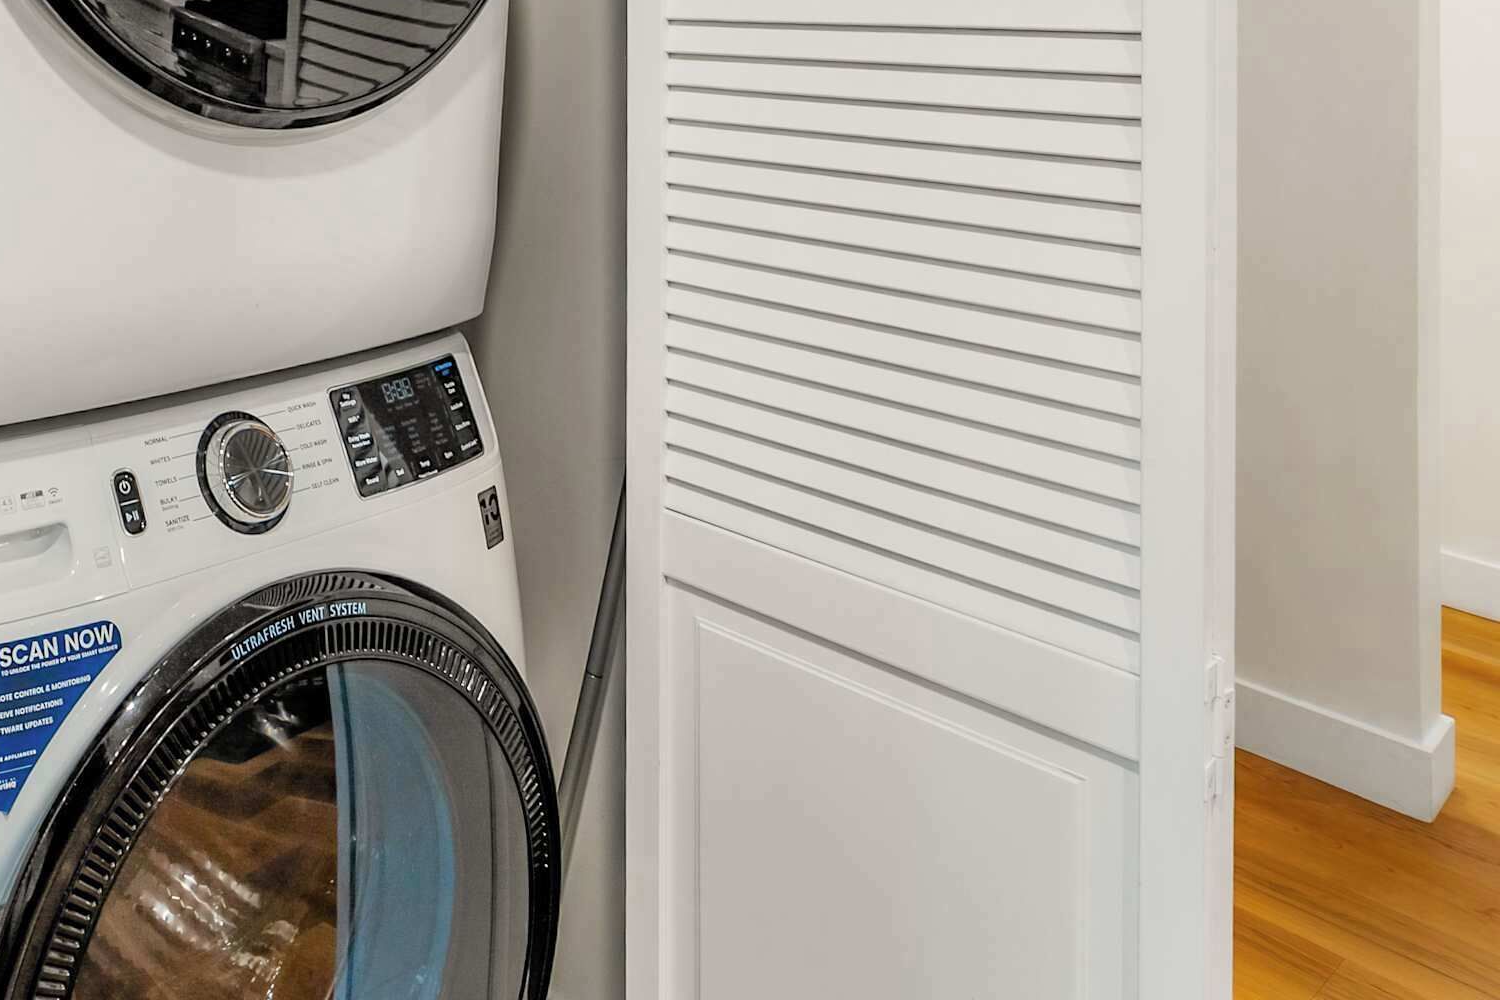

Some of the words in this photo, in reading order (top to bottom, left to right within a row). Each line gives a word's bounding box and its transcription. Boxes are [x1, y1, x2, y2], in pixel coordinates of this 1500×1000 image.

[155, 476, 177, 487] TOWELS
[231, 616, 295, 661] ULTRAFRESH
[298, 606, 325, 625] VENT
[330, 602, 367, 617] SYSTEM
[0, 636, 58, 668] SCAN
[64, 624, 114, 653] NOW
[14, 686, 44, 700] CONTROL
[51, 675, 91, 691] MONITORING
[14, 699, 63, 717] NOTIFICATIONS
[24, 716, 54, 730] UPDATES
